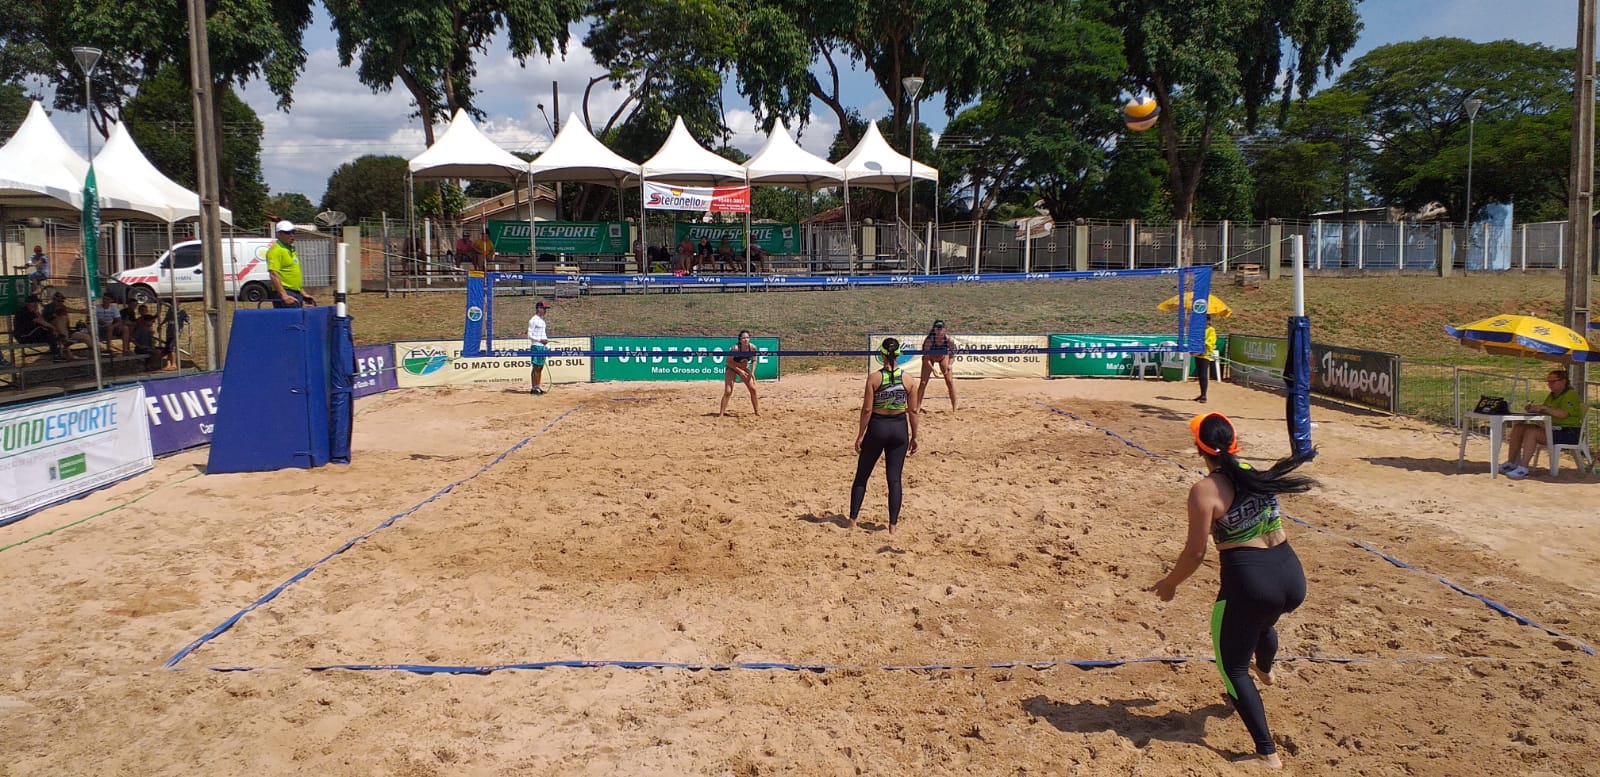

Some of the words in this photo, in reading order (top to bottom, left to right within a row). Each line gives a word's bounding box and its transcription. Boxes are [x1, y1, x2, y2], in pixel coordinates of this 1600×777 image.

[603, 345, 769, 363] FUNDESPOE
[967, 355, 1004, 364] GROSSO
[1007, 355, 1020, 363] DO
[1023, 355, 1041, 363] SUL
[454, 362, 468, 370] DO
[472, 361, 499, 370] MATO
[503, 360, 532, 368] GROS
[548, 359, 562, 367] DO
[566, 358, 584, 366] SUL
[145, 386, 222, 426] FUNE
[0, 402, 118, 452] UNDESPORTE
